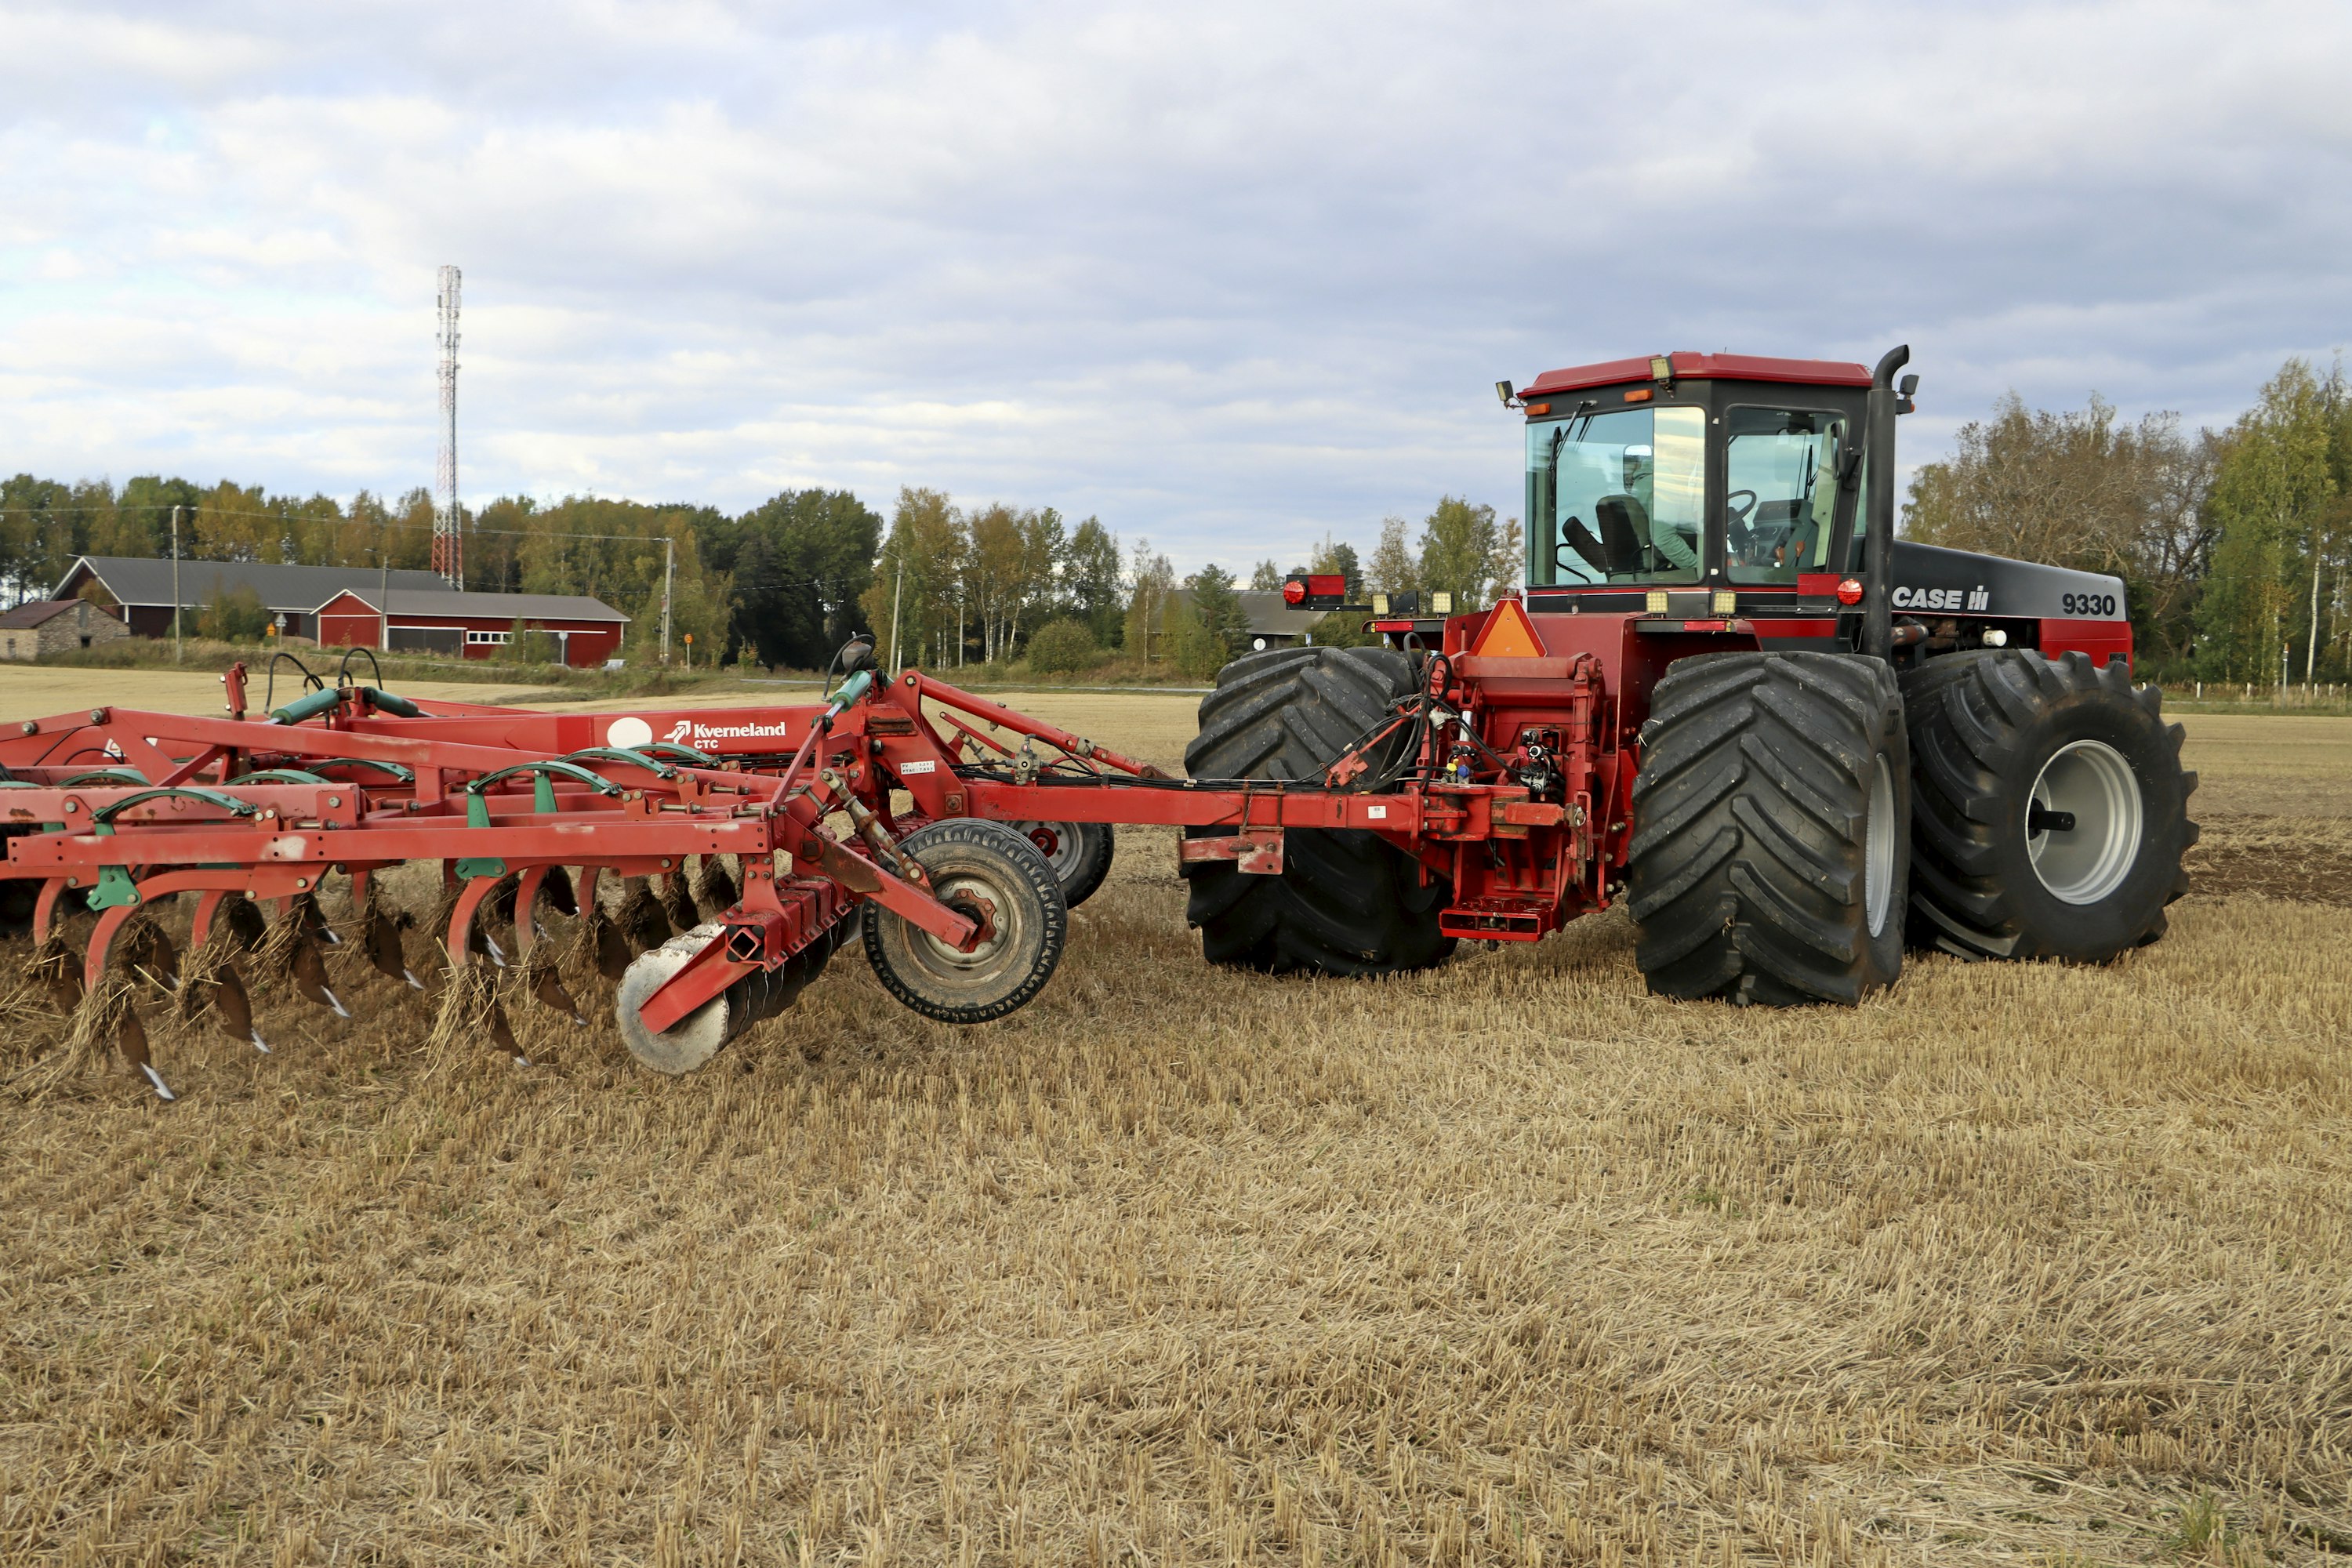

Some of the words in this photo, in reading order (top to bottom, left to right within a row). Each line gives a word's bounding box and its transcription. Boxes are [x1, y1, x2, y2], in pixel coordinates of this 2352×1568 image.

[1892, 586, 1963, 609] CASE
[2062, 593, 2115, 616] 9330
[694, 721, 786, 738] Kverneland
[694, 739, 718, 749] CTC
